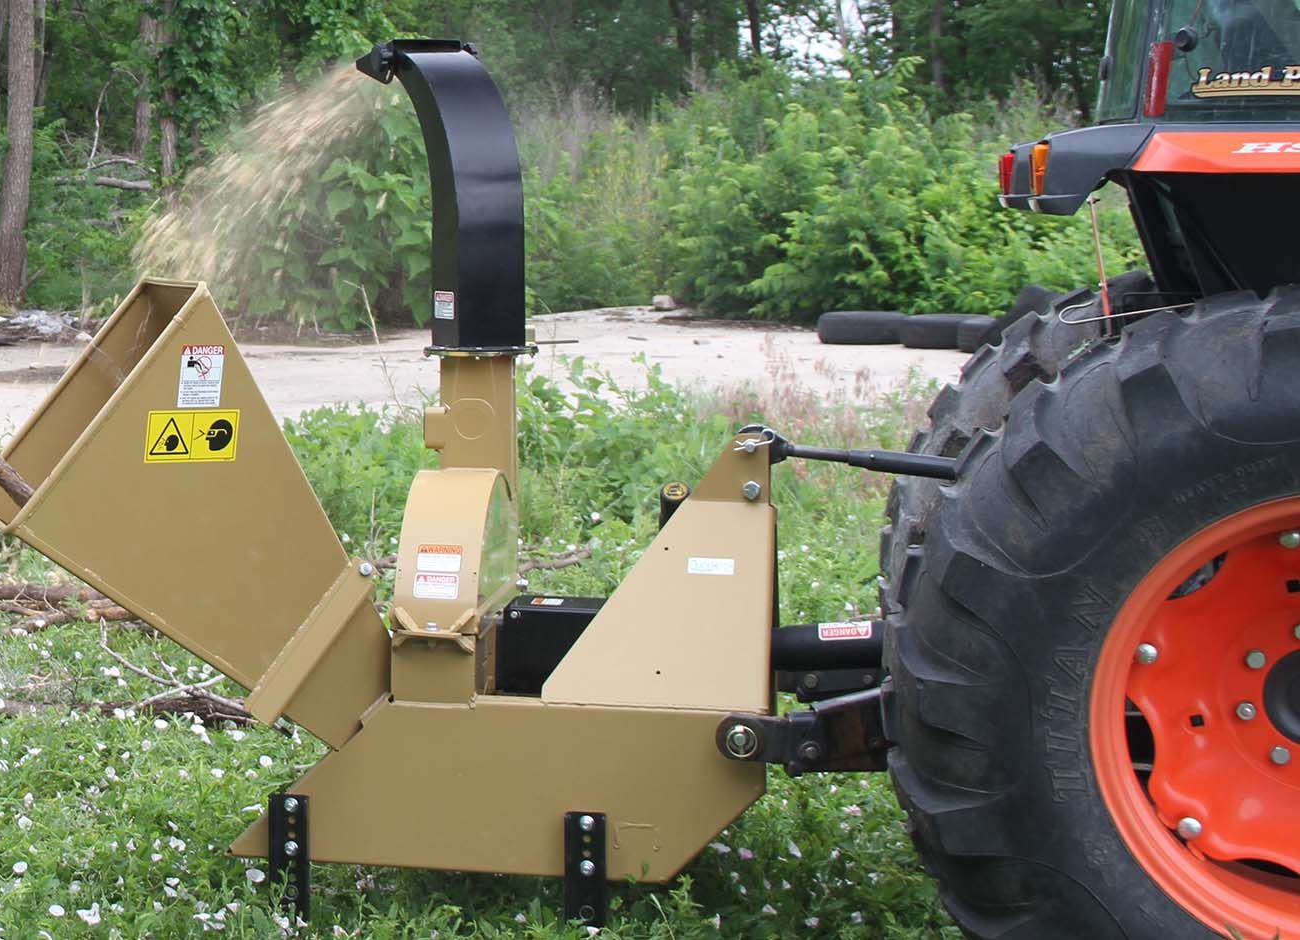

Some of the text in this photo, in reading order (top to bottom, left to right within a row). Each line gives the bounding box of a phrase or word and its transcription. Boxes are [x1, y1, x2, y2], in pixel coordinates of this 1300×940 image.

[1195, 66, 1272, 89] Land
[192, 346, 223, 355] DANGER
[822, 628, 858, 636] DANGER
[1041, 583, 1113, 802] TITAN
